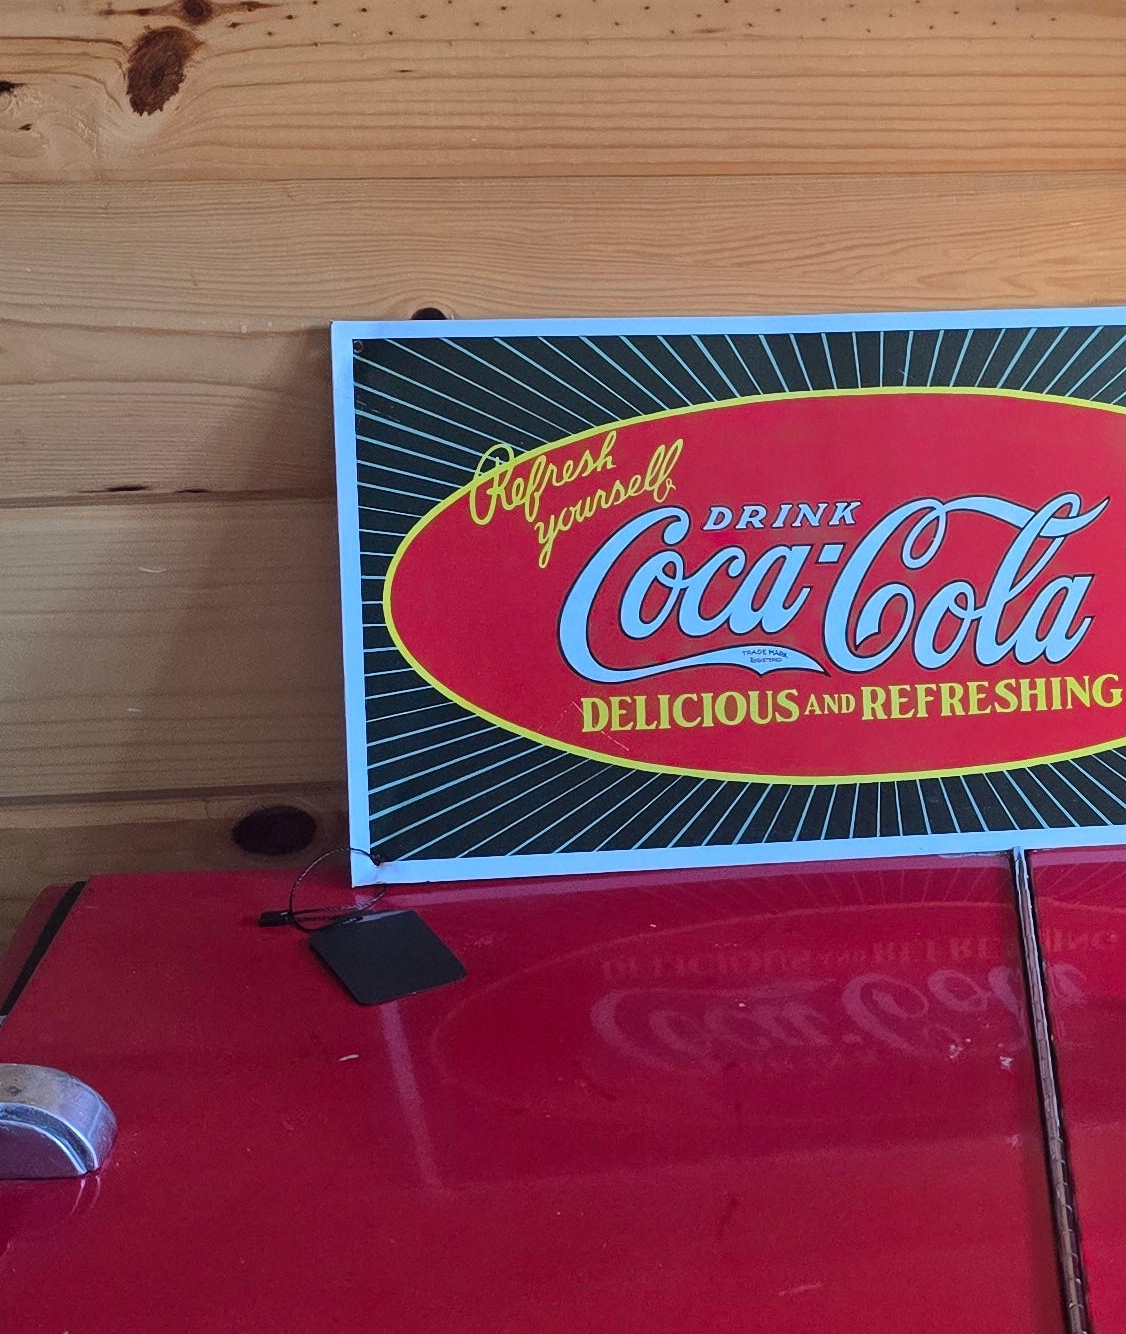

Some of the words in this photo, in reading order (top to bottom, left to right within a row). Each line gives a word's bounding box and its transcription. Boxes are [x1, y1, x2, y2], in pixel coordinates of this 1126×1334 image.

[469, 430, 617, 526] Refresh
[534, 438, 684, 569] yourself
[702, 501, 863, 532] DRINK
[557, 492, 1111, 684] Coca-Cola
[581, 688, 800, 734] DELICIOUS
[804, 693, 856, 716] AND
[861, 673, 1124, 722] REFRESHING
